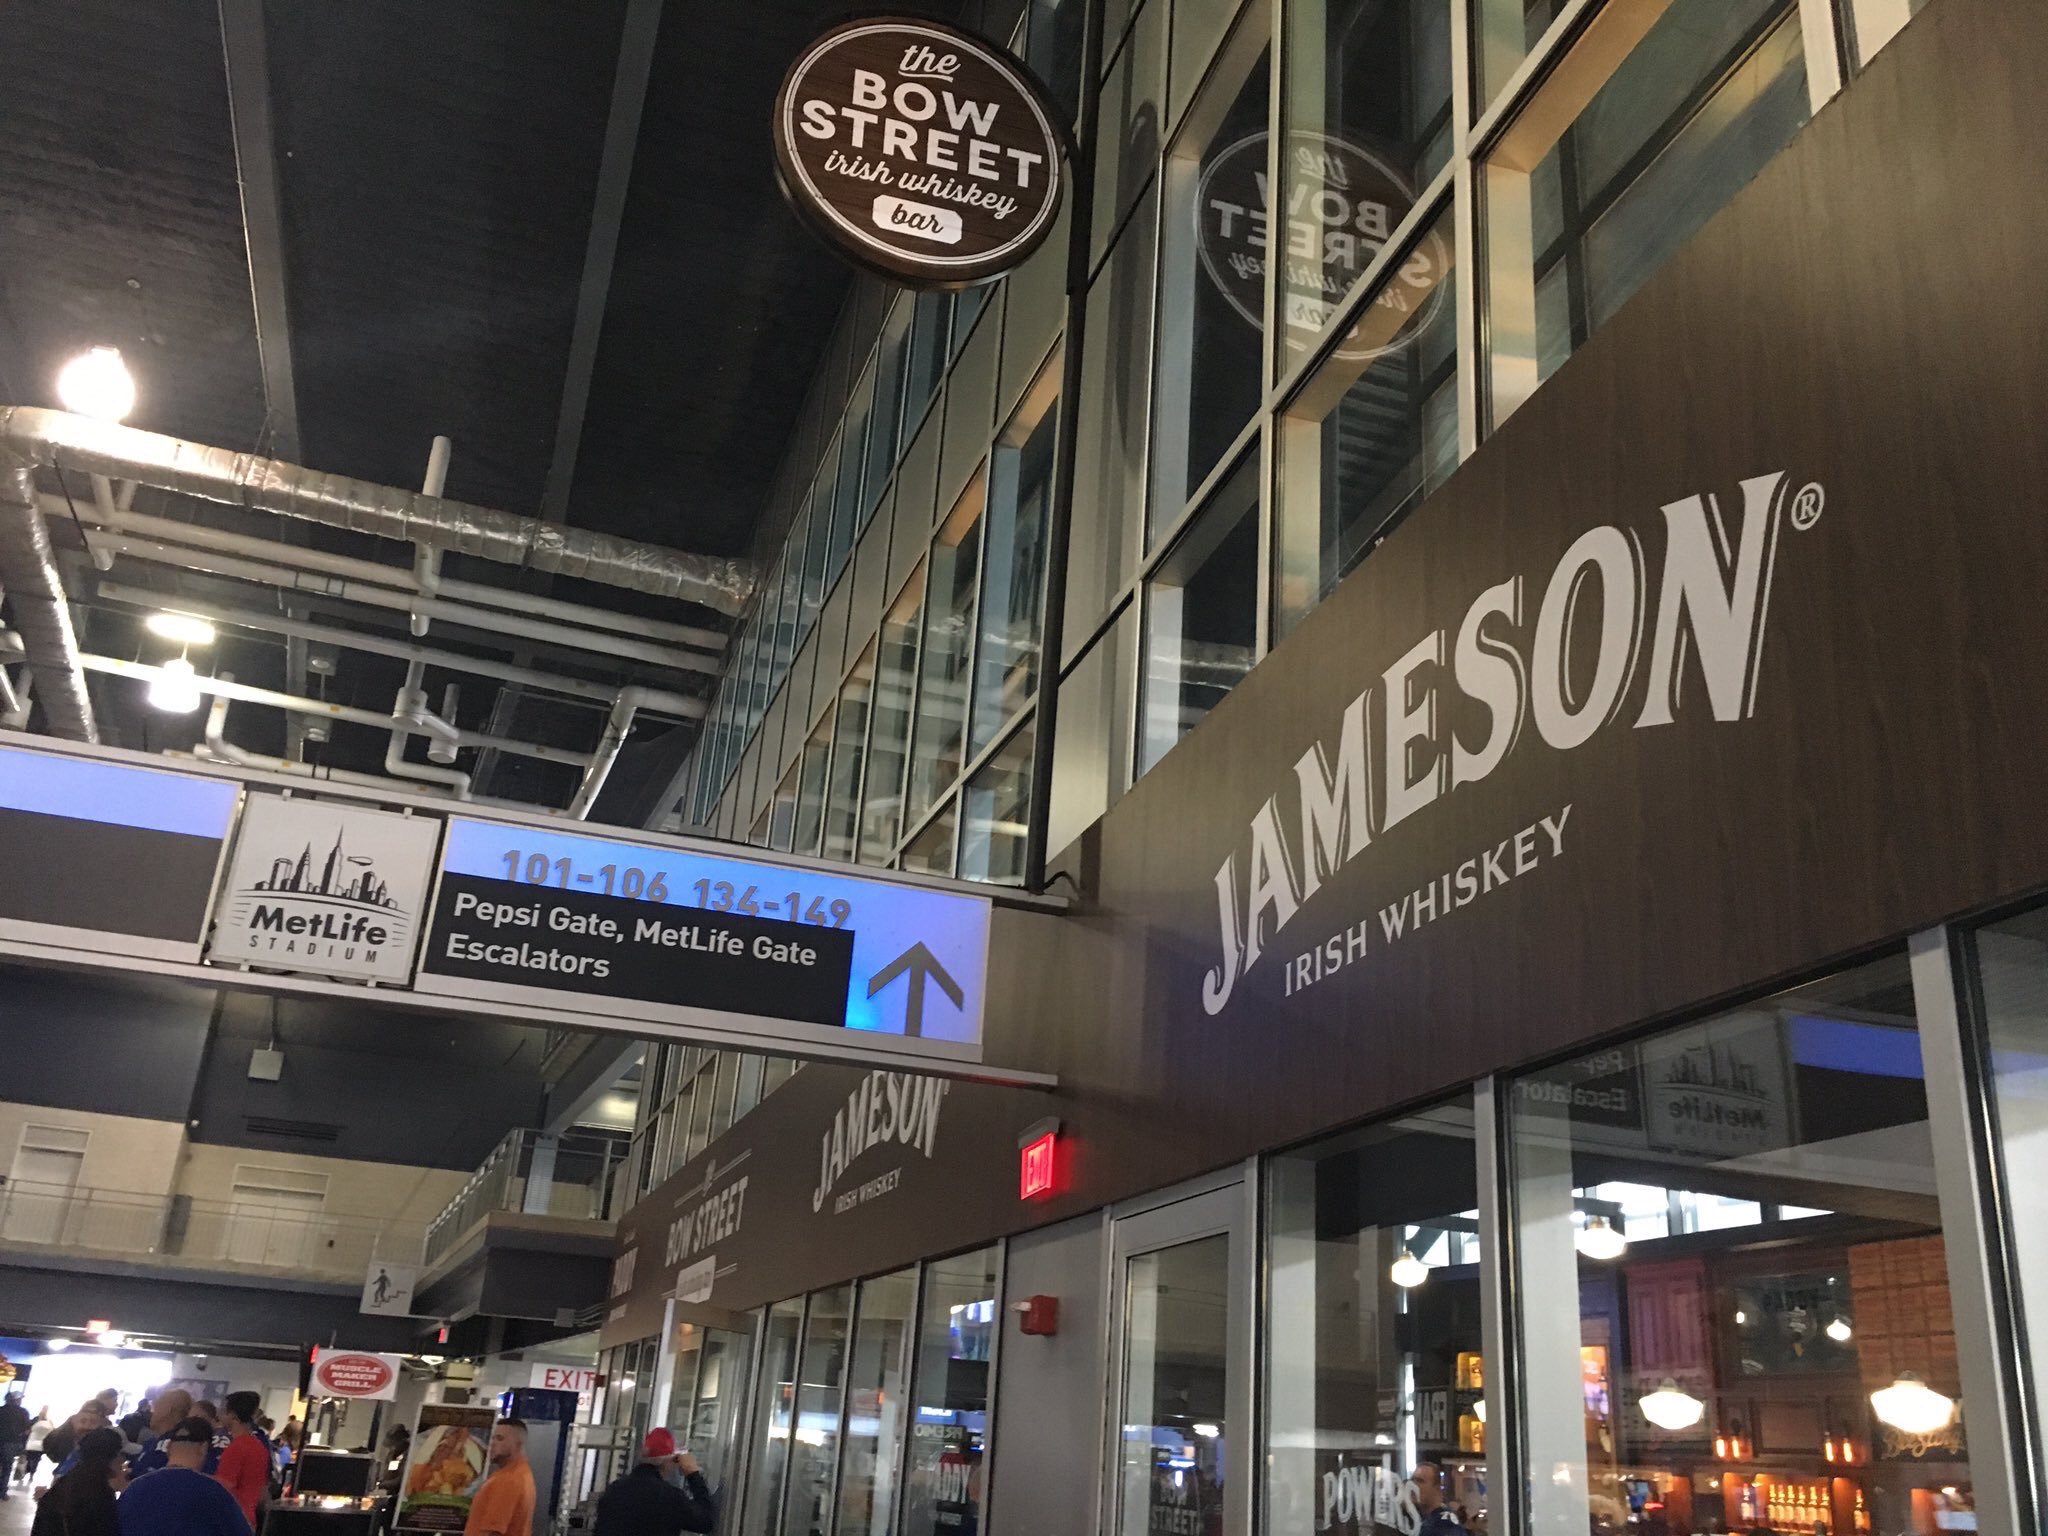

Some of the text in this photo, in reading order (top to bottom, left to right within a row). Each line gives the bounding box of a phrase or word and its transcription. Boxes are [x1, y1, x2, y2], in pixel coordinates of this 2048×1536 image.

[899, 44, 961, 80] the
[851, 69, 1000, 137] BOW
[799, 99, 1042, 188] STREET
[824, 150, 1018, 220] irish whiskey
[891, 203, 944, 234] bar
[1202, 470, 1790, 1016] JAMESON
[503, 849, 852, 929] 101-106 134-149
[1284, 803, 1574, 998] IRISH WHISKEY
[248, 934, 378, 963] STADIUM
[249, 905, 388, 946] MetLife
[446, 932, 611, 978] Escalators
[453, 892, 818, 967] Pepsi Gate, MetLife Gate
[813, 1069, 944, 1214] JAMESON
[693, 1175, 749, 1254] STREET
[544, 1368, 597, 1391] EXIT
[1323, 1466, 1422, 1536] POWERS
